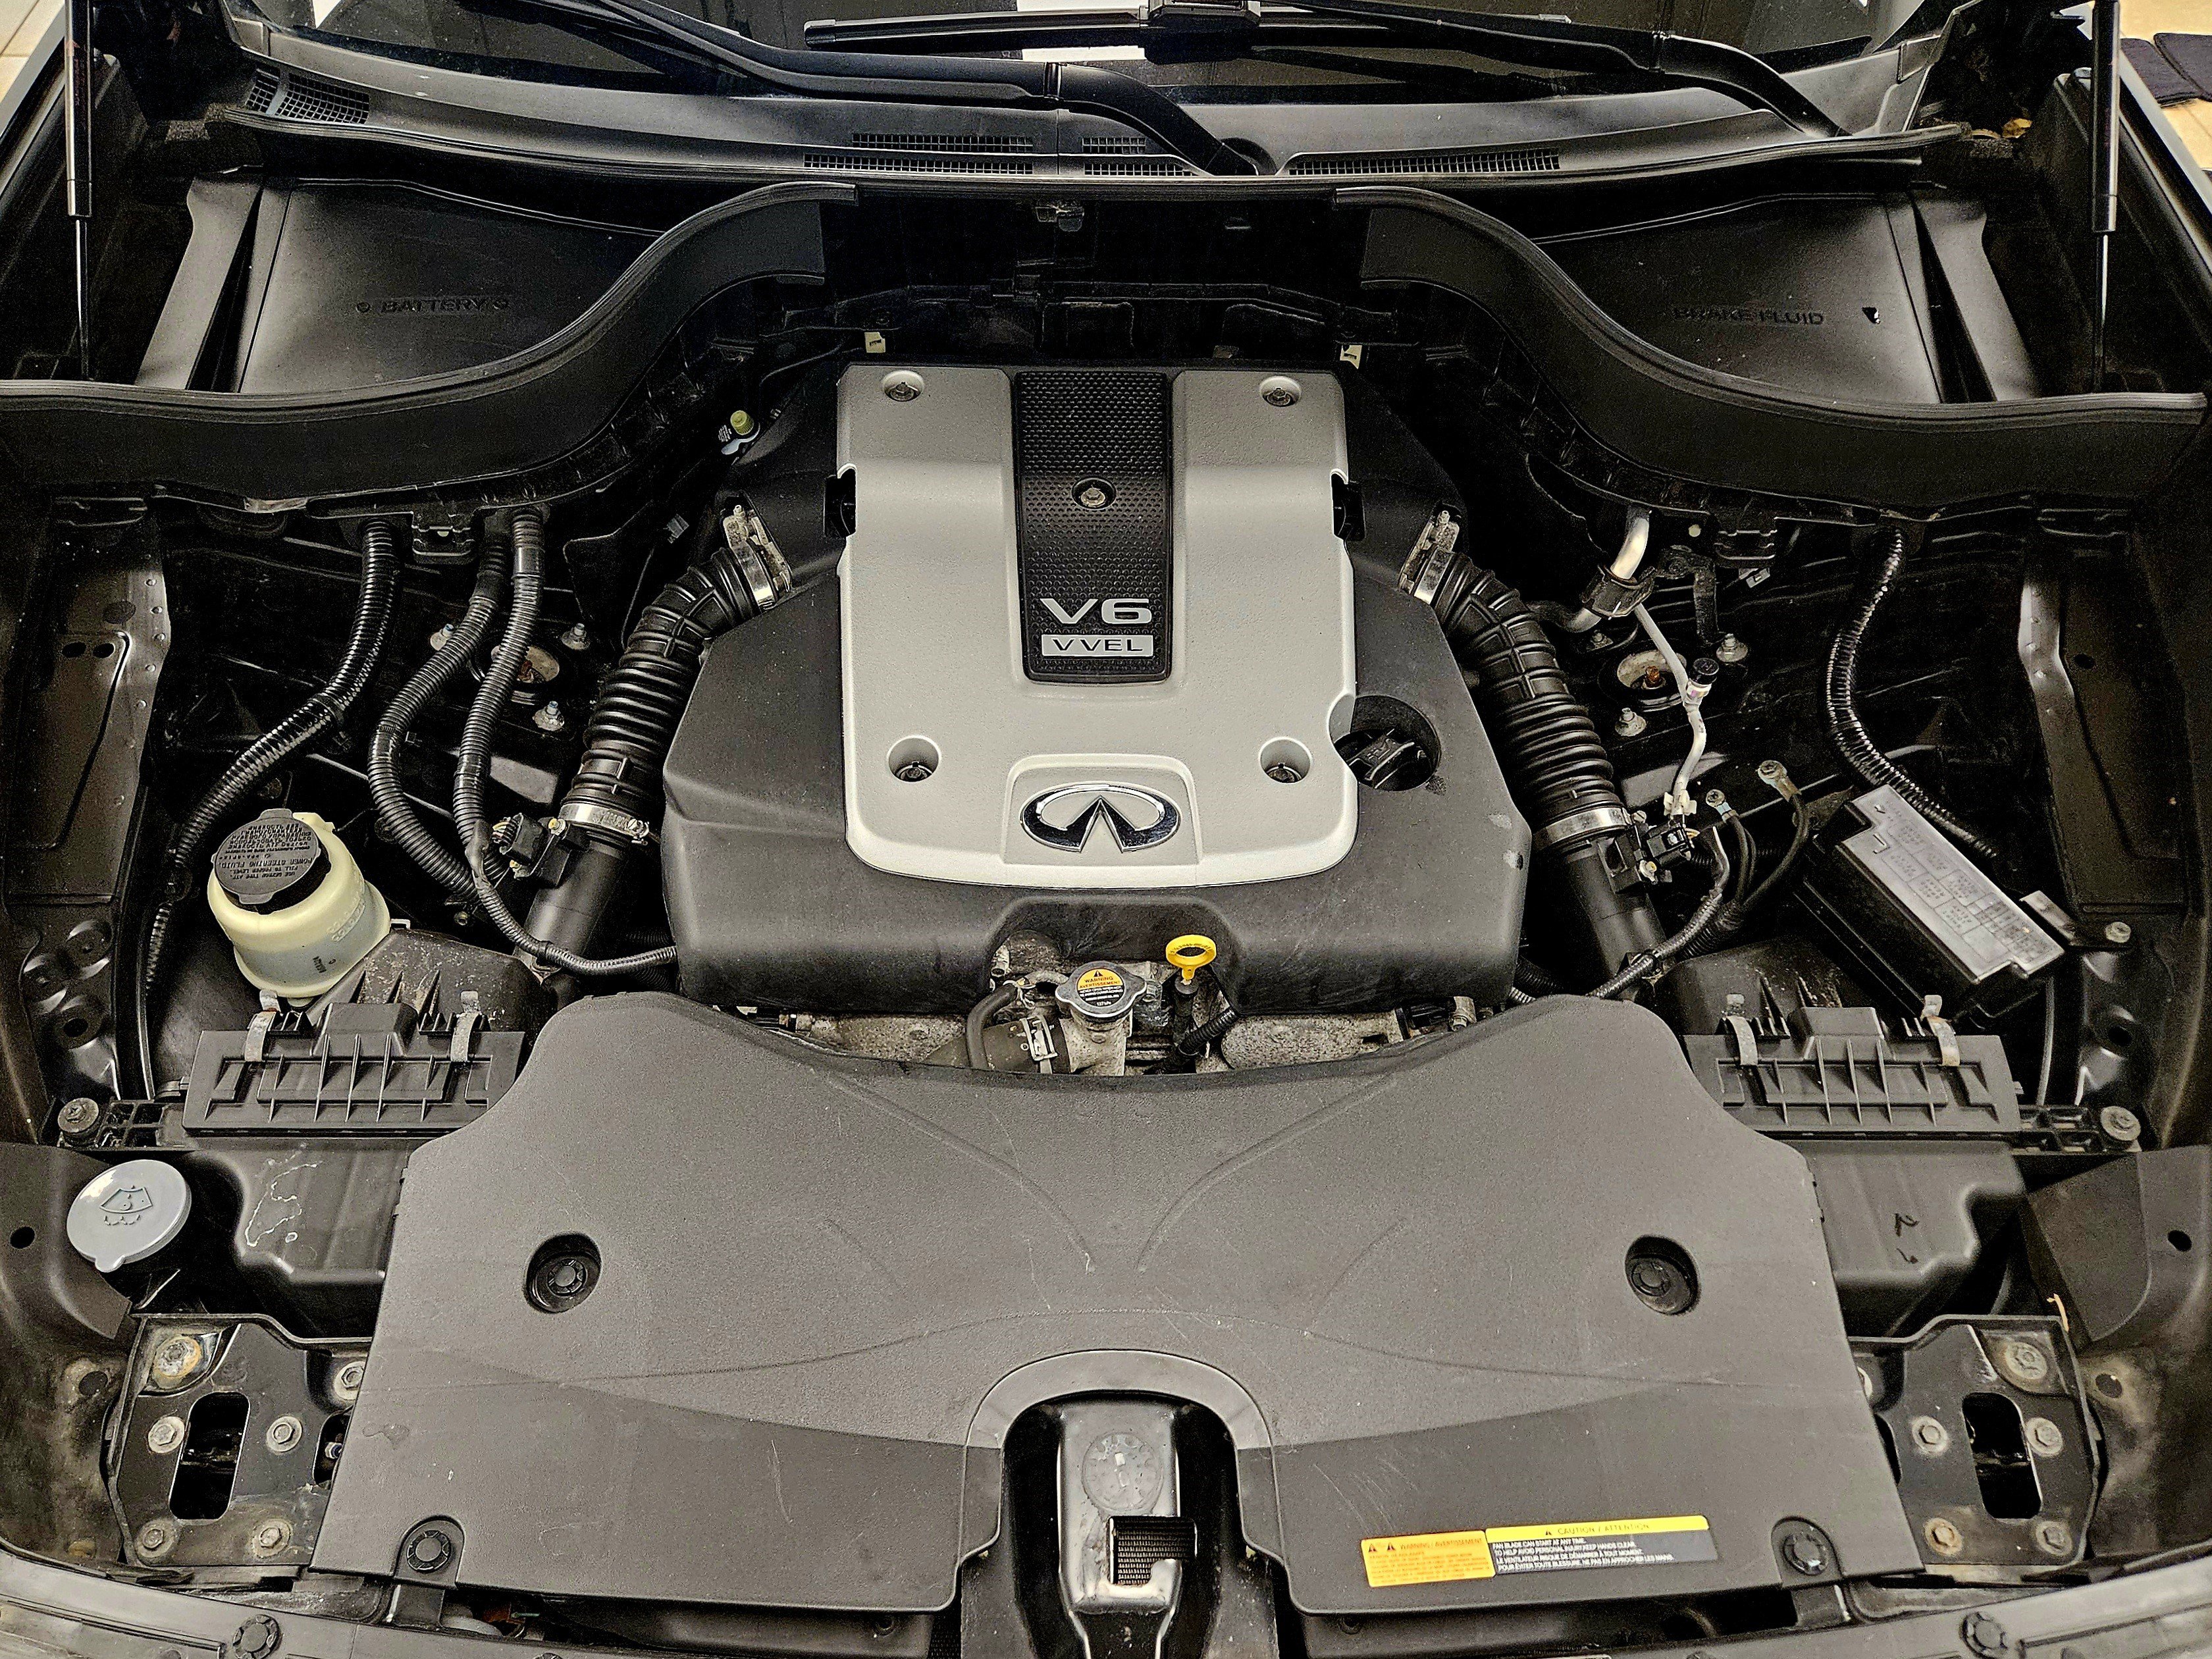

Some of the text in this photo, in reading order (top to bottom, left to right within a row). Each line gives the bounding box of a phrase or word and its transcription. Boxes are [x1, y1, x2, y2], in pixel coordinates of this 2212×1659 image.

[1758, 307, 1824, 325] FLUID
[1040, 598, 1152, 625] V6
[1558, 1526, 1595, 1535] CAUTION
[1605, 1522, 1649, 1532] ATTENTION
